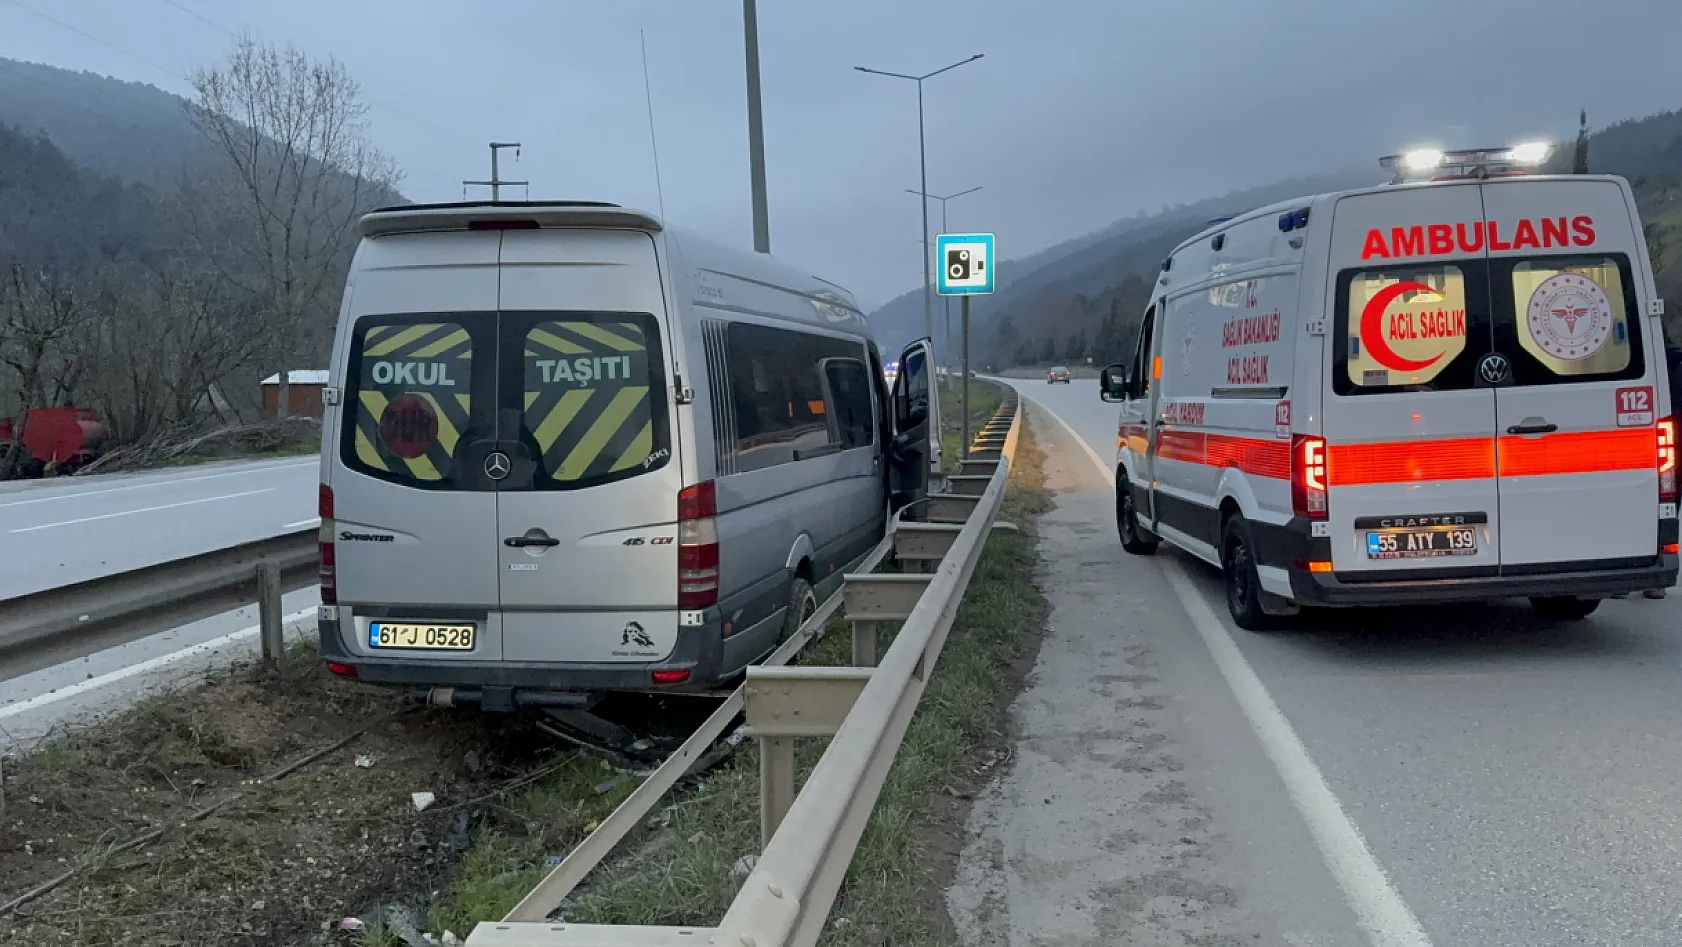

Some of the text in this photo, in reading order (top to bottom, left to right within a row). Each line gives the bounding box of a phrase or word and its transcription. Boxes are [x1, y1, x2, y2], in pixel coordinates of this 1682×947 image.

[1361, 215, 1597, 260] AMBULANS
[1420, 307, 1466, 339] SAĞLIK
[372, 356, 631, 387] OKUL TAŞITI
[1621, 391, 1648, 411] 112
[1380, 516, 1465, 527] CRAFTER
[1379, 531, 1473, 551] 55 ATY 139
[380, 626, 471, 646] 61 J 0528
